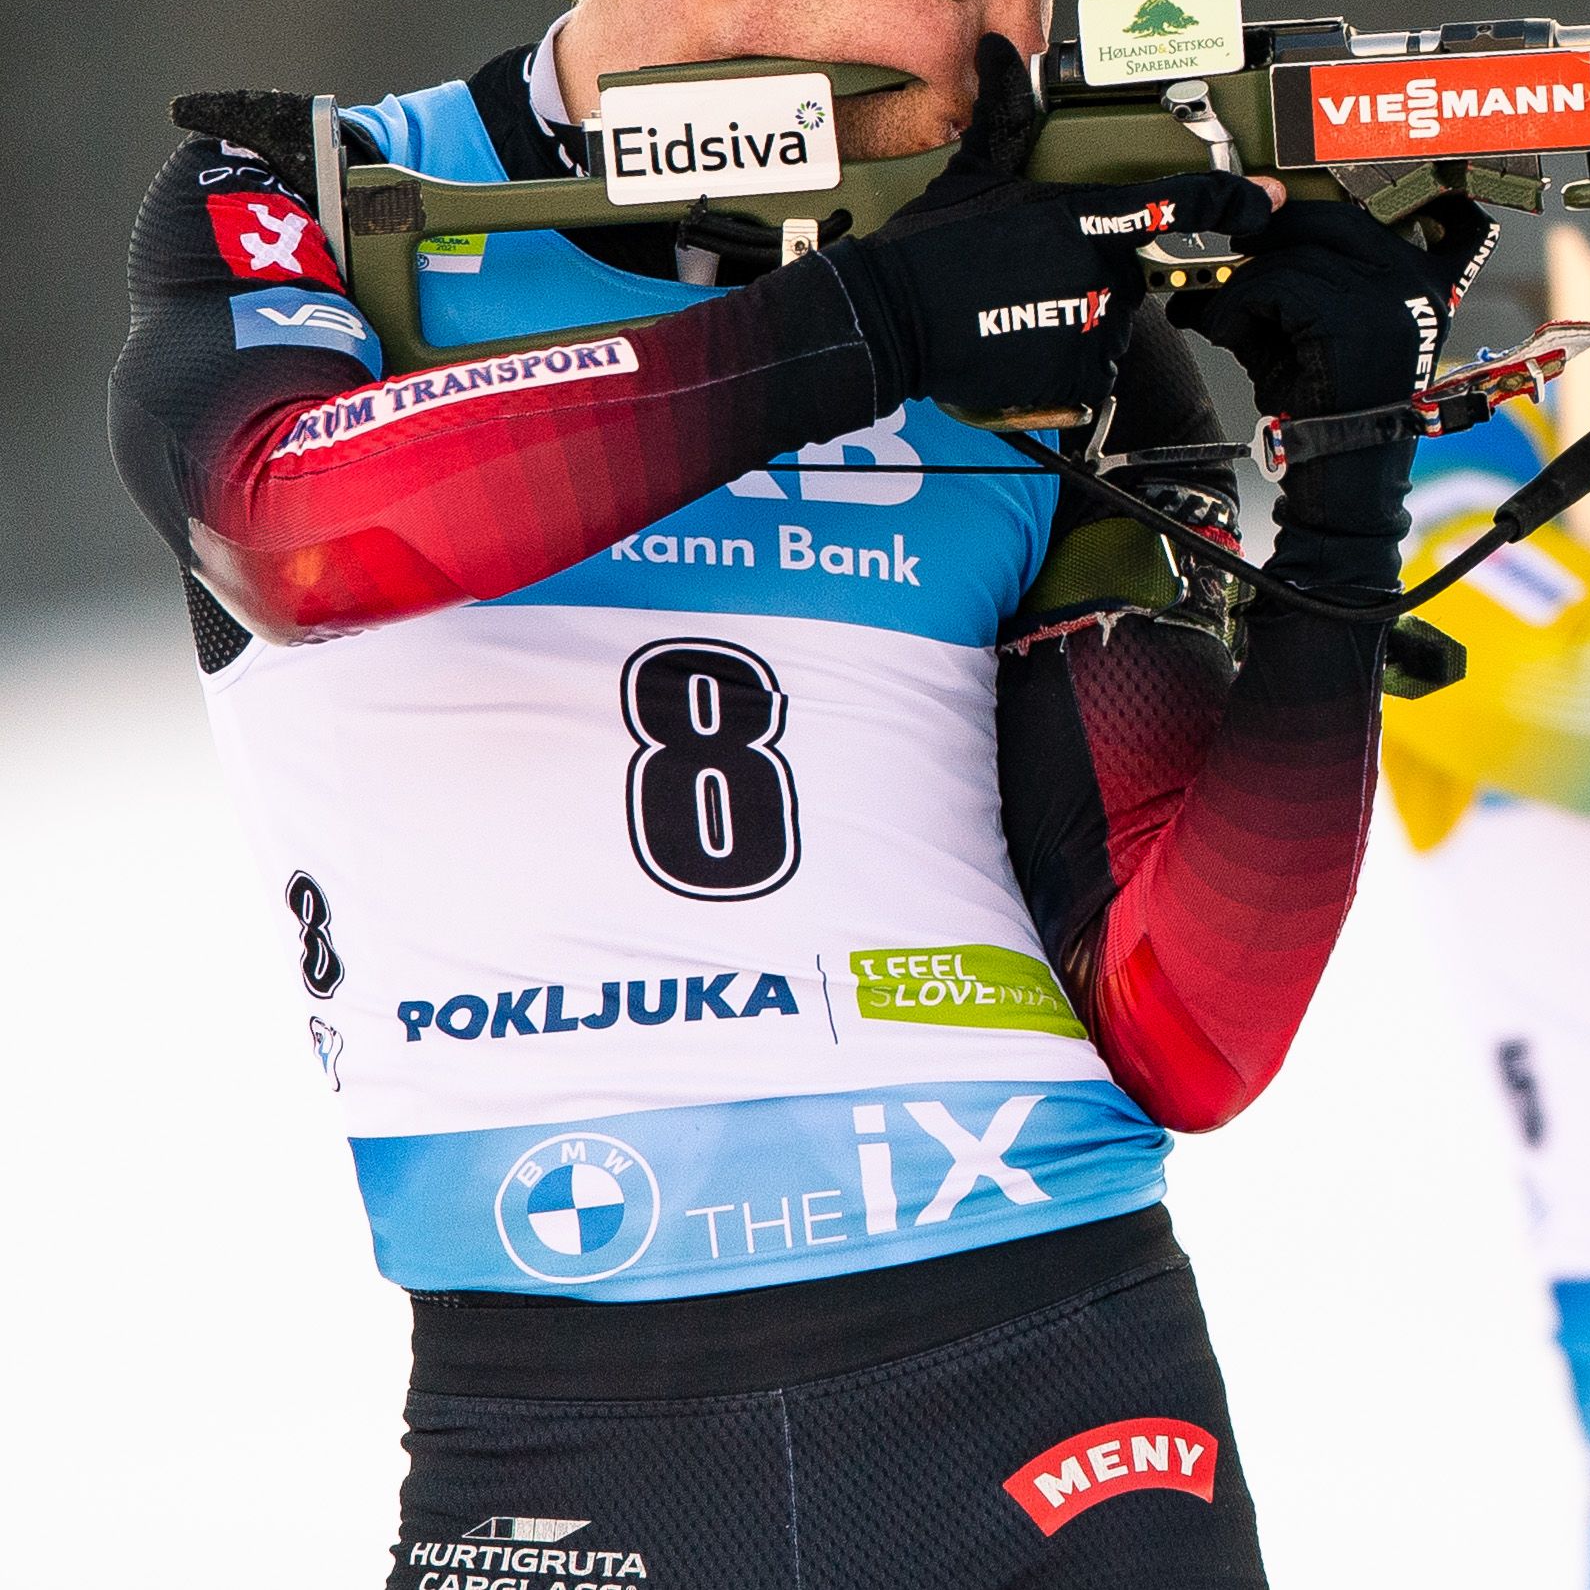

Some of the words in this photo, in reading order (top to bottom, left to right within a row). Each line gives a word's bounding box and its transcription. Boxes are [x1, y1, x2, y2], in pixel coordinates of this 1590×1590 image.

[1317, 77, 1587, 140] VIESSMANN
[613, 122, 809, 178] Eidsiva
[386, 341, 623, 413] TRANSPORT
[1404, 296, 1438, 393] KINET
[777, 523, 921, 586] Bank
[620, 636, 801, 902] 8
[285, 870, 345, 1000] 8
[886, 953, 977, 982] FEEL
[398, 972, 799, 1043] POKLJUKA
[518, 1142, 632, 1186] BMW
[686, 1189, 848, 1261] THE
[852, 1094, 1053, 1237] iX
[1033, 1432, 1204, 1509] MENY
[409, 1541, 648, 1579] HURTIGRUTA
